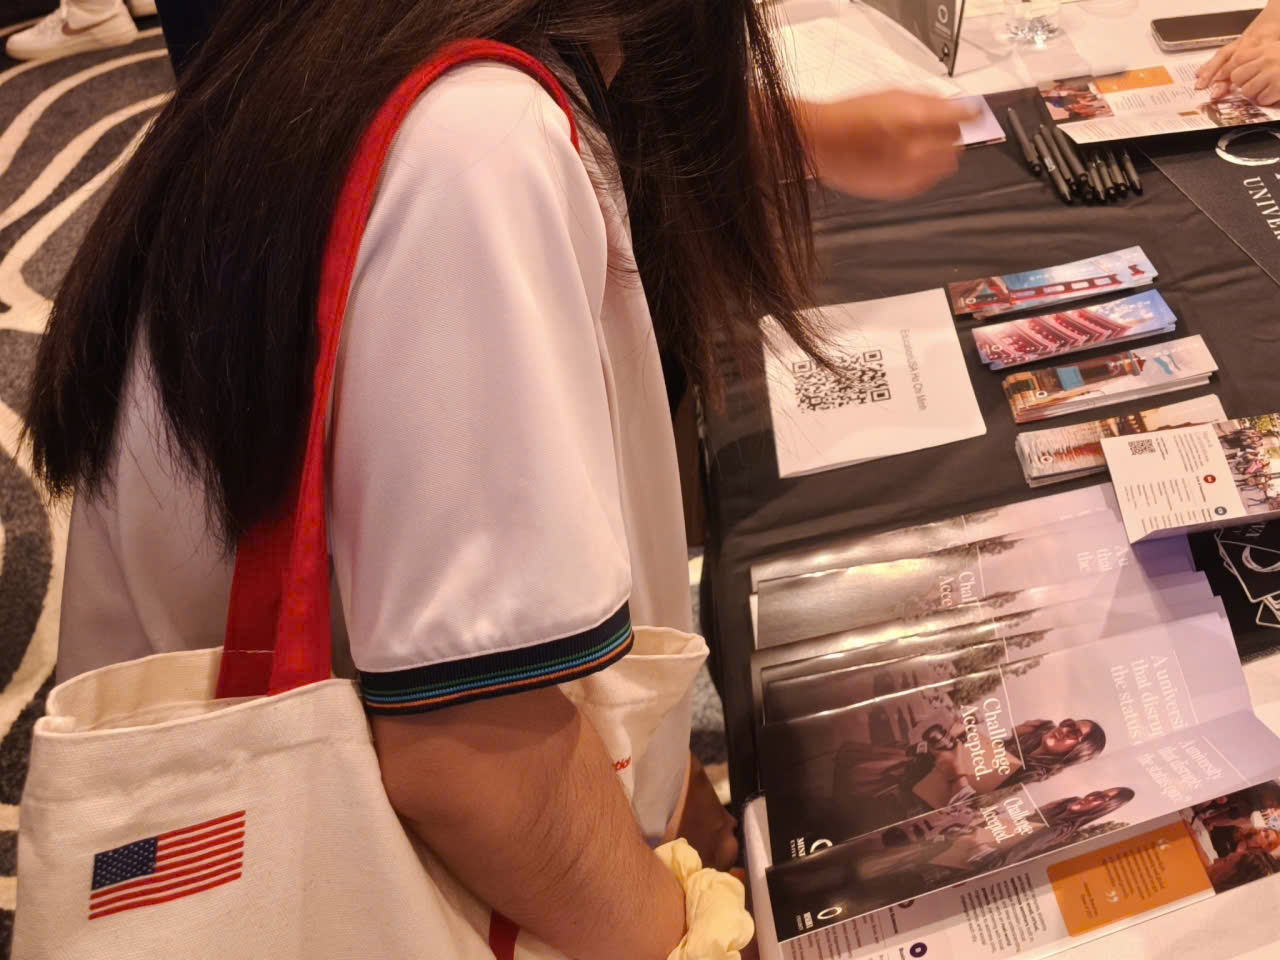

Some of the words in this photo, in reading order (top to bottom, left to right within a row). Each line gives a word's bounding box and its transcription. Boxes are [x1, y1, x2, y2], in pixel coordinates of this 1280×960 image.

[1110, 664, 1129, 690] the
[1130, 659, 1152, 691] that
[1141, 692, 1166, 738] disru
[1156, 669, 1189, 730] universi
[960, 704, 993, 781] Accepted.
[983, 697, 1011, 775] Challenge
